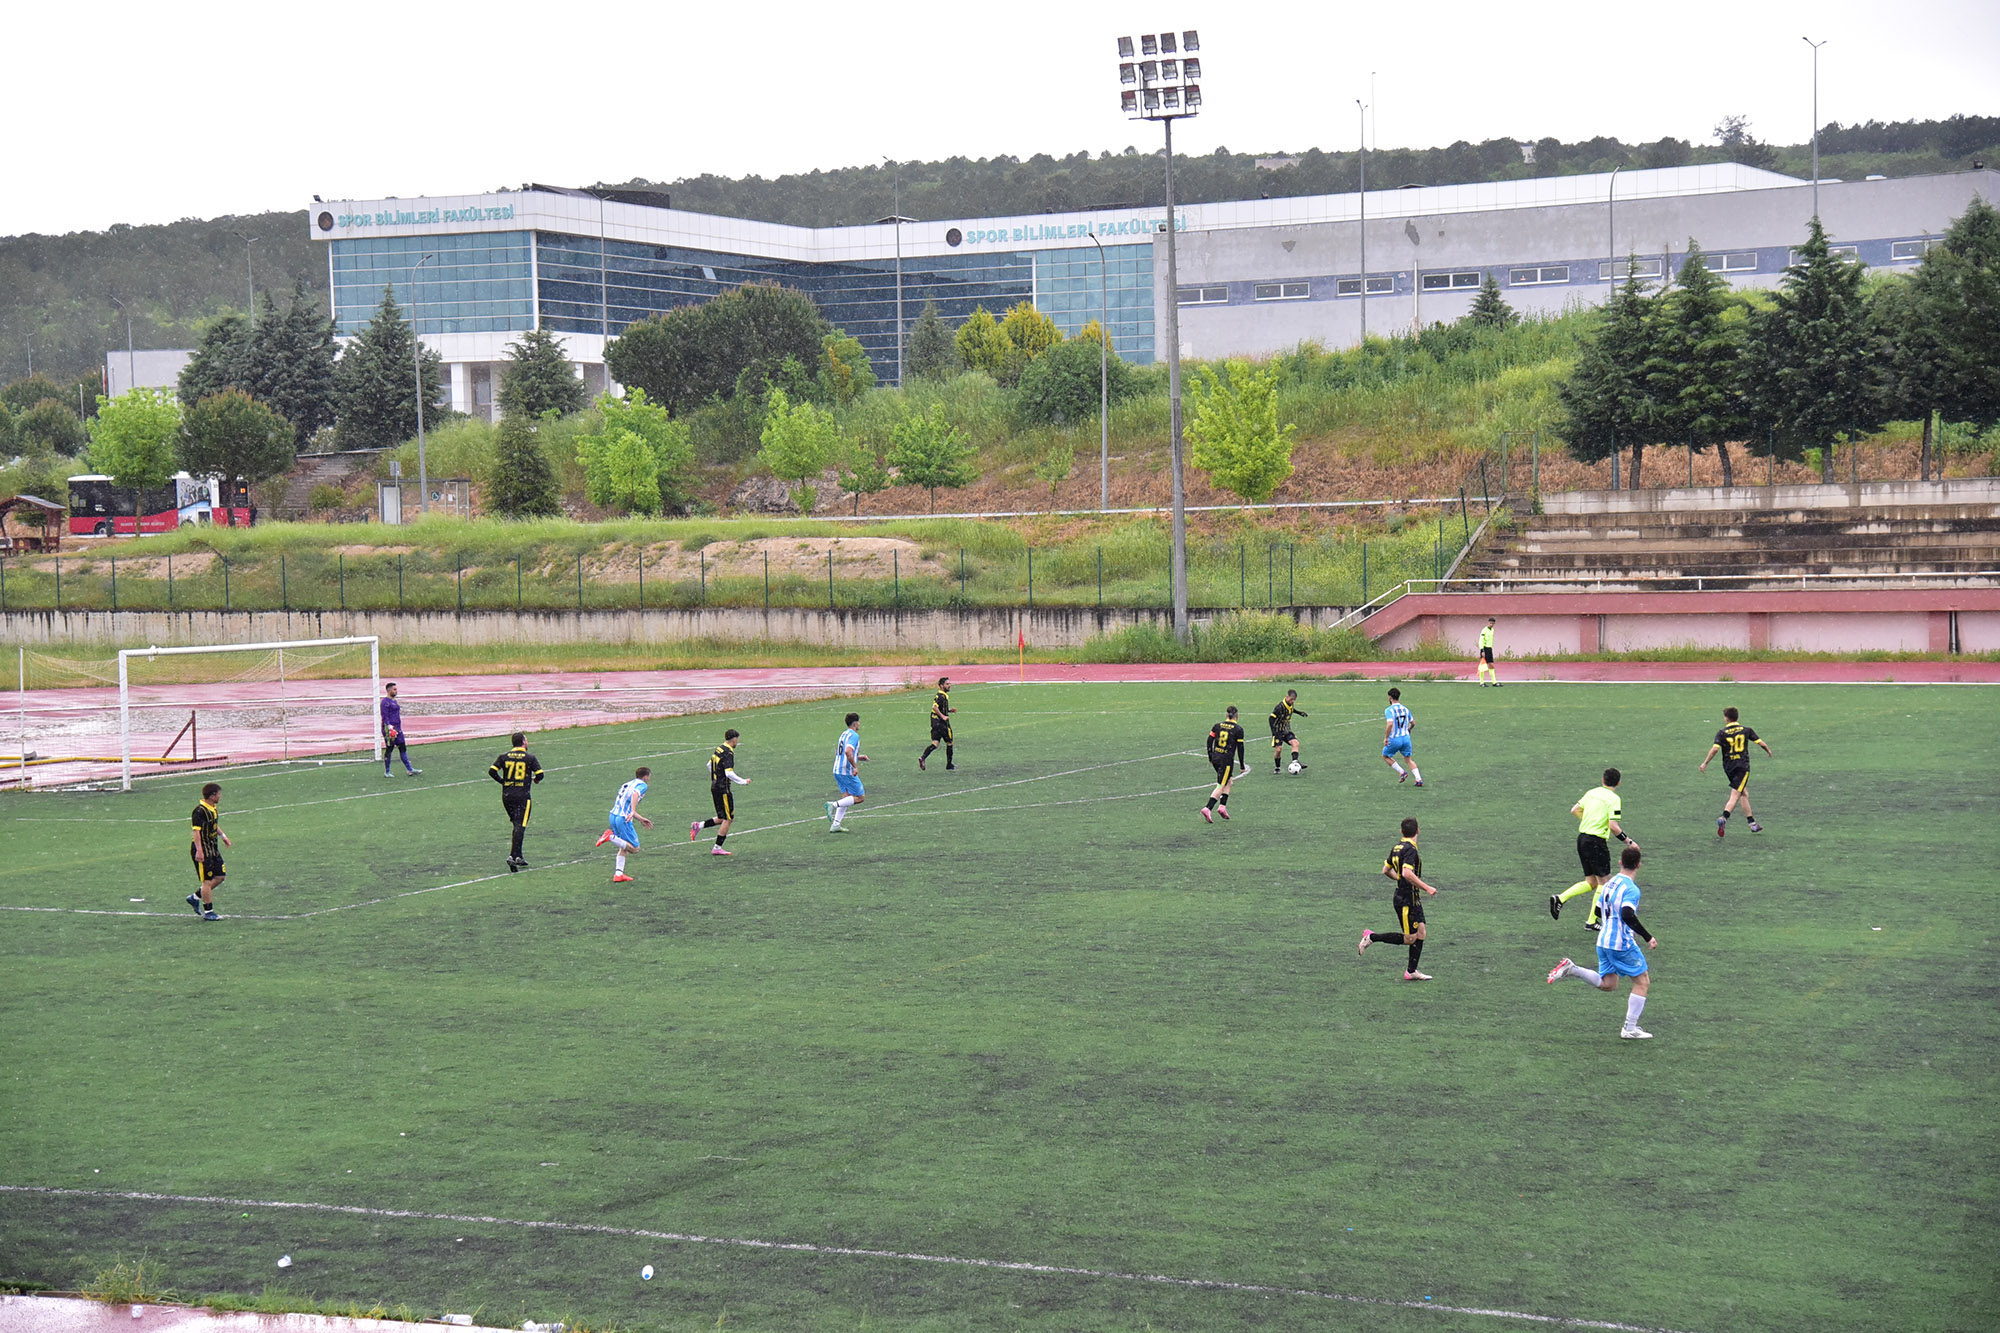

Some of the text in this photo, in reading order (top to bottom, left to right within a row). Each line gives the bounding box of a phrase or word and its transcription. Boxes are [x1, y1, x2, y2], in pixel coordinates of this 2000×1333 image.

[337, 204, 514, 228] SPOR BİLİMLERİ FAKÜLTESİ
[967, 229, 1008, 244] SPOR
[1012, 221, 1093, 242] BİLİMLERİ
[1396, 715, 1407, 729] 17
[1218, 730, 1229, 748] 8
[504, 761, 526, 780] 78
